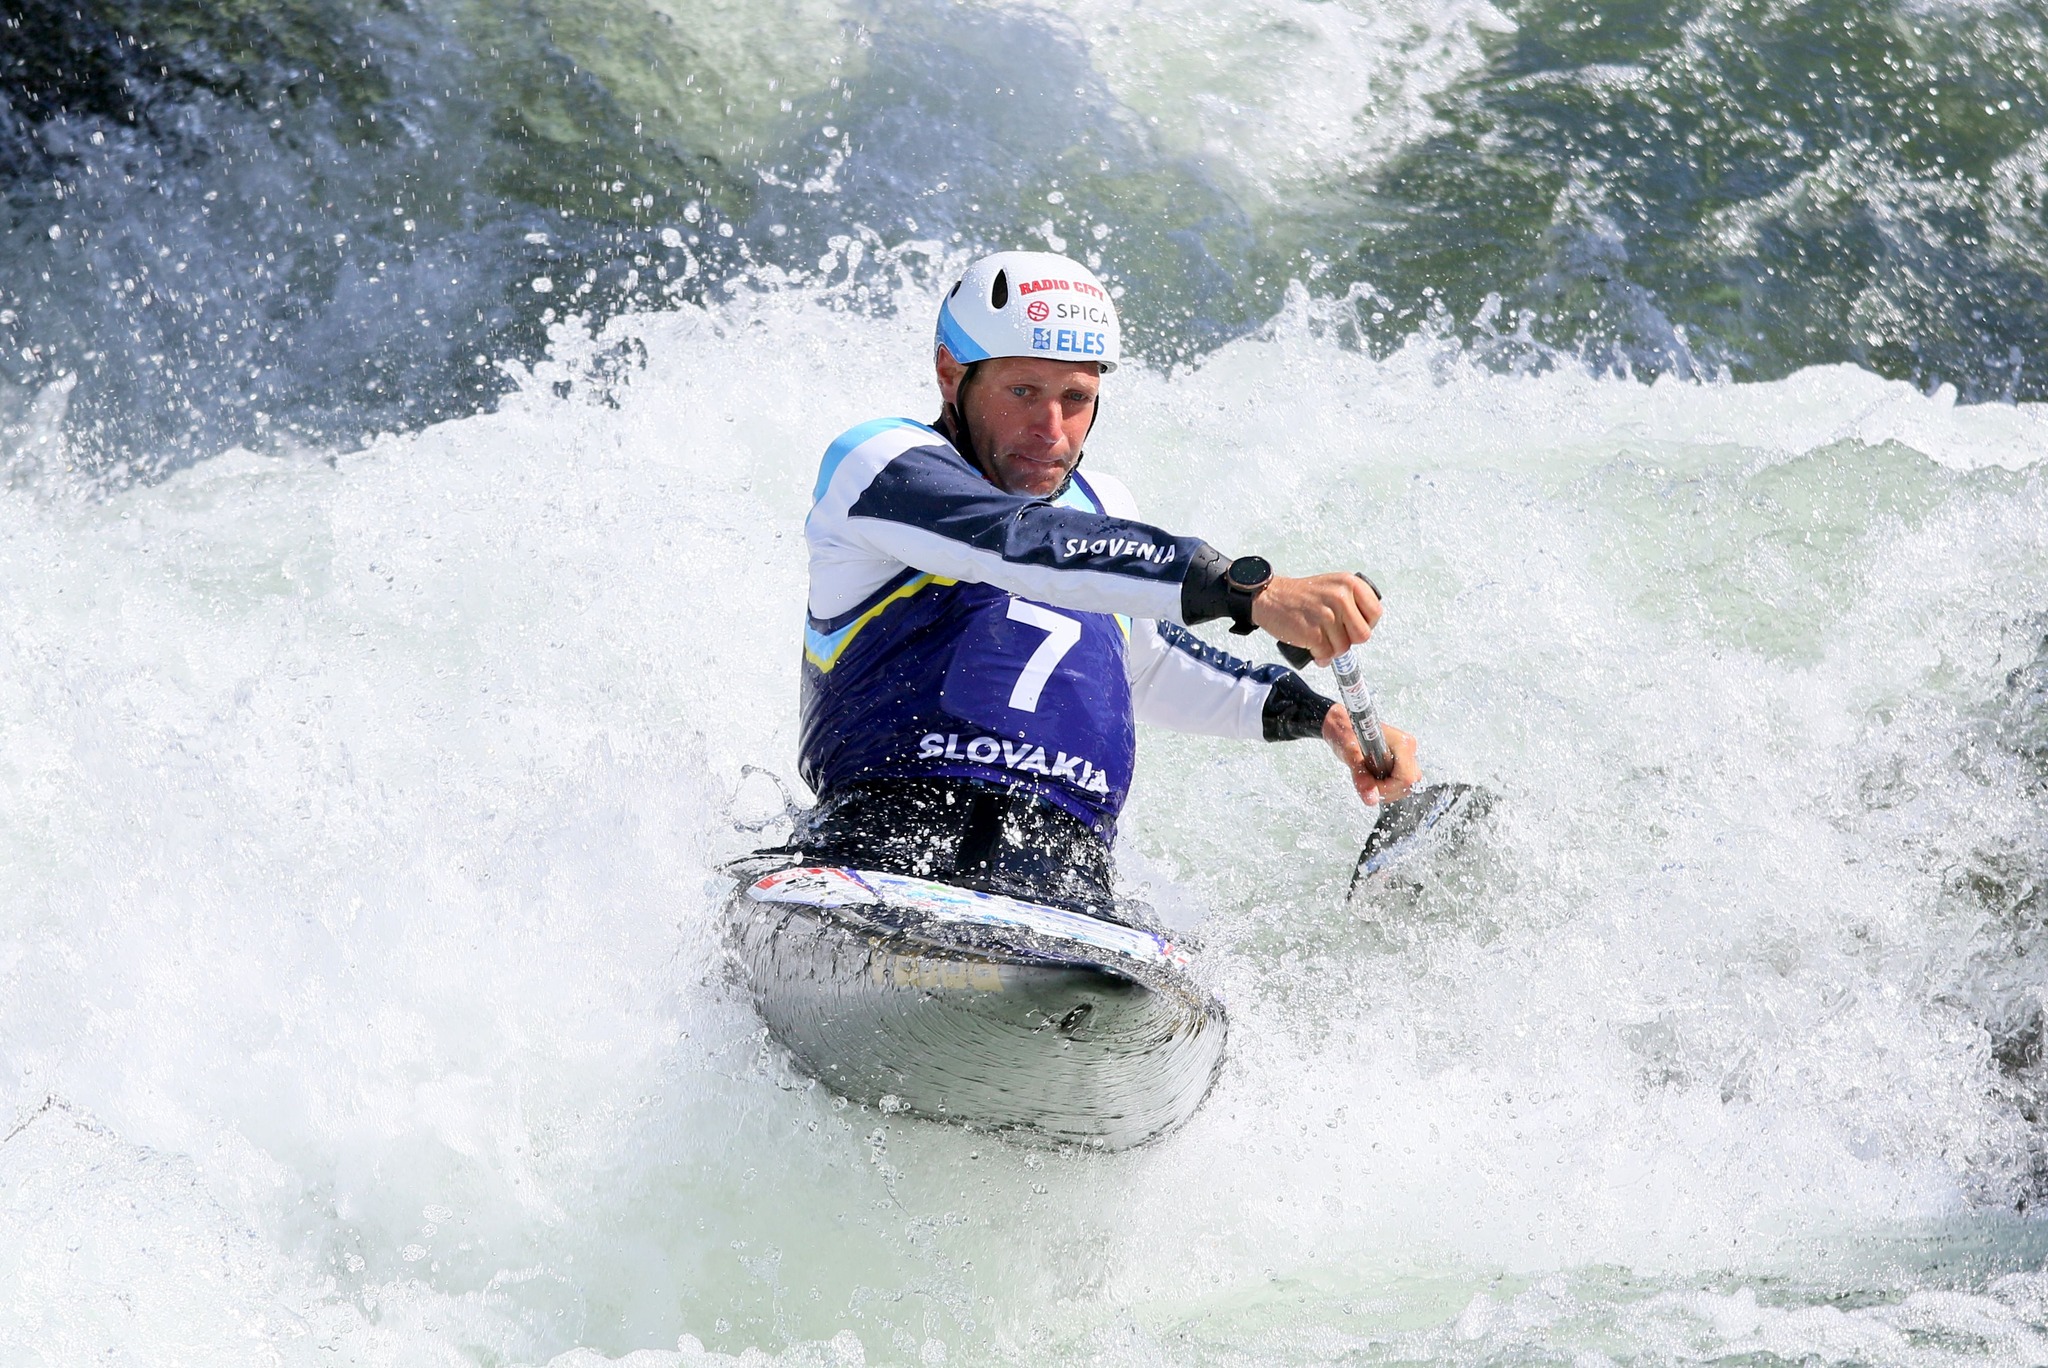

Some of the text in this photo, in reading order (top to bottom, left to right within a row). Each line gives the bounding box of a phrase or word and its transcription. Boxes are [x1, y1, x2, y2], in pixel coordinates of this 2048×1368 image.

[1019, 279, 1104, 301] RADIO CITY
[1057, 303, 1109, 327] SPICA
[1056, 329, 1105, 355] ELES
[1064, 538, 1176, 564] SLOVENIA
[1006, 598, 1082, 713] 7
[918, 733, 1109, 793] SLOVAKIA
